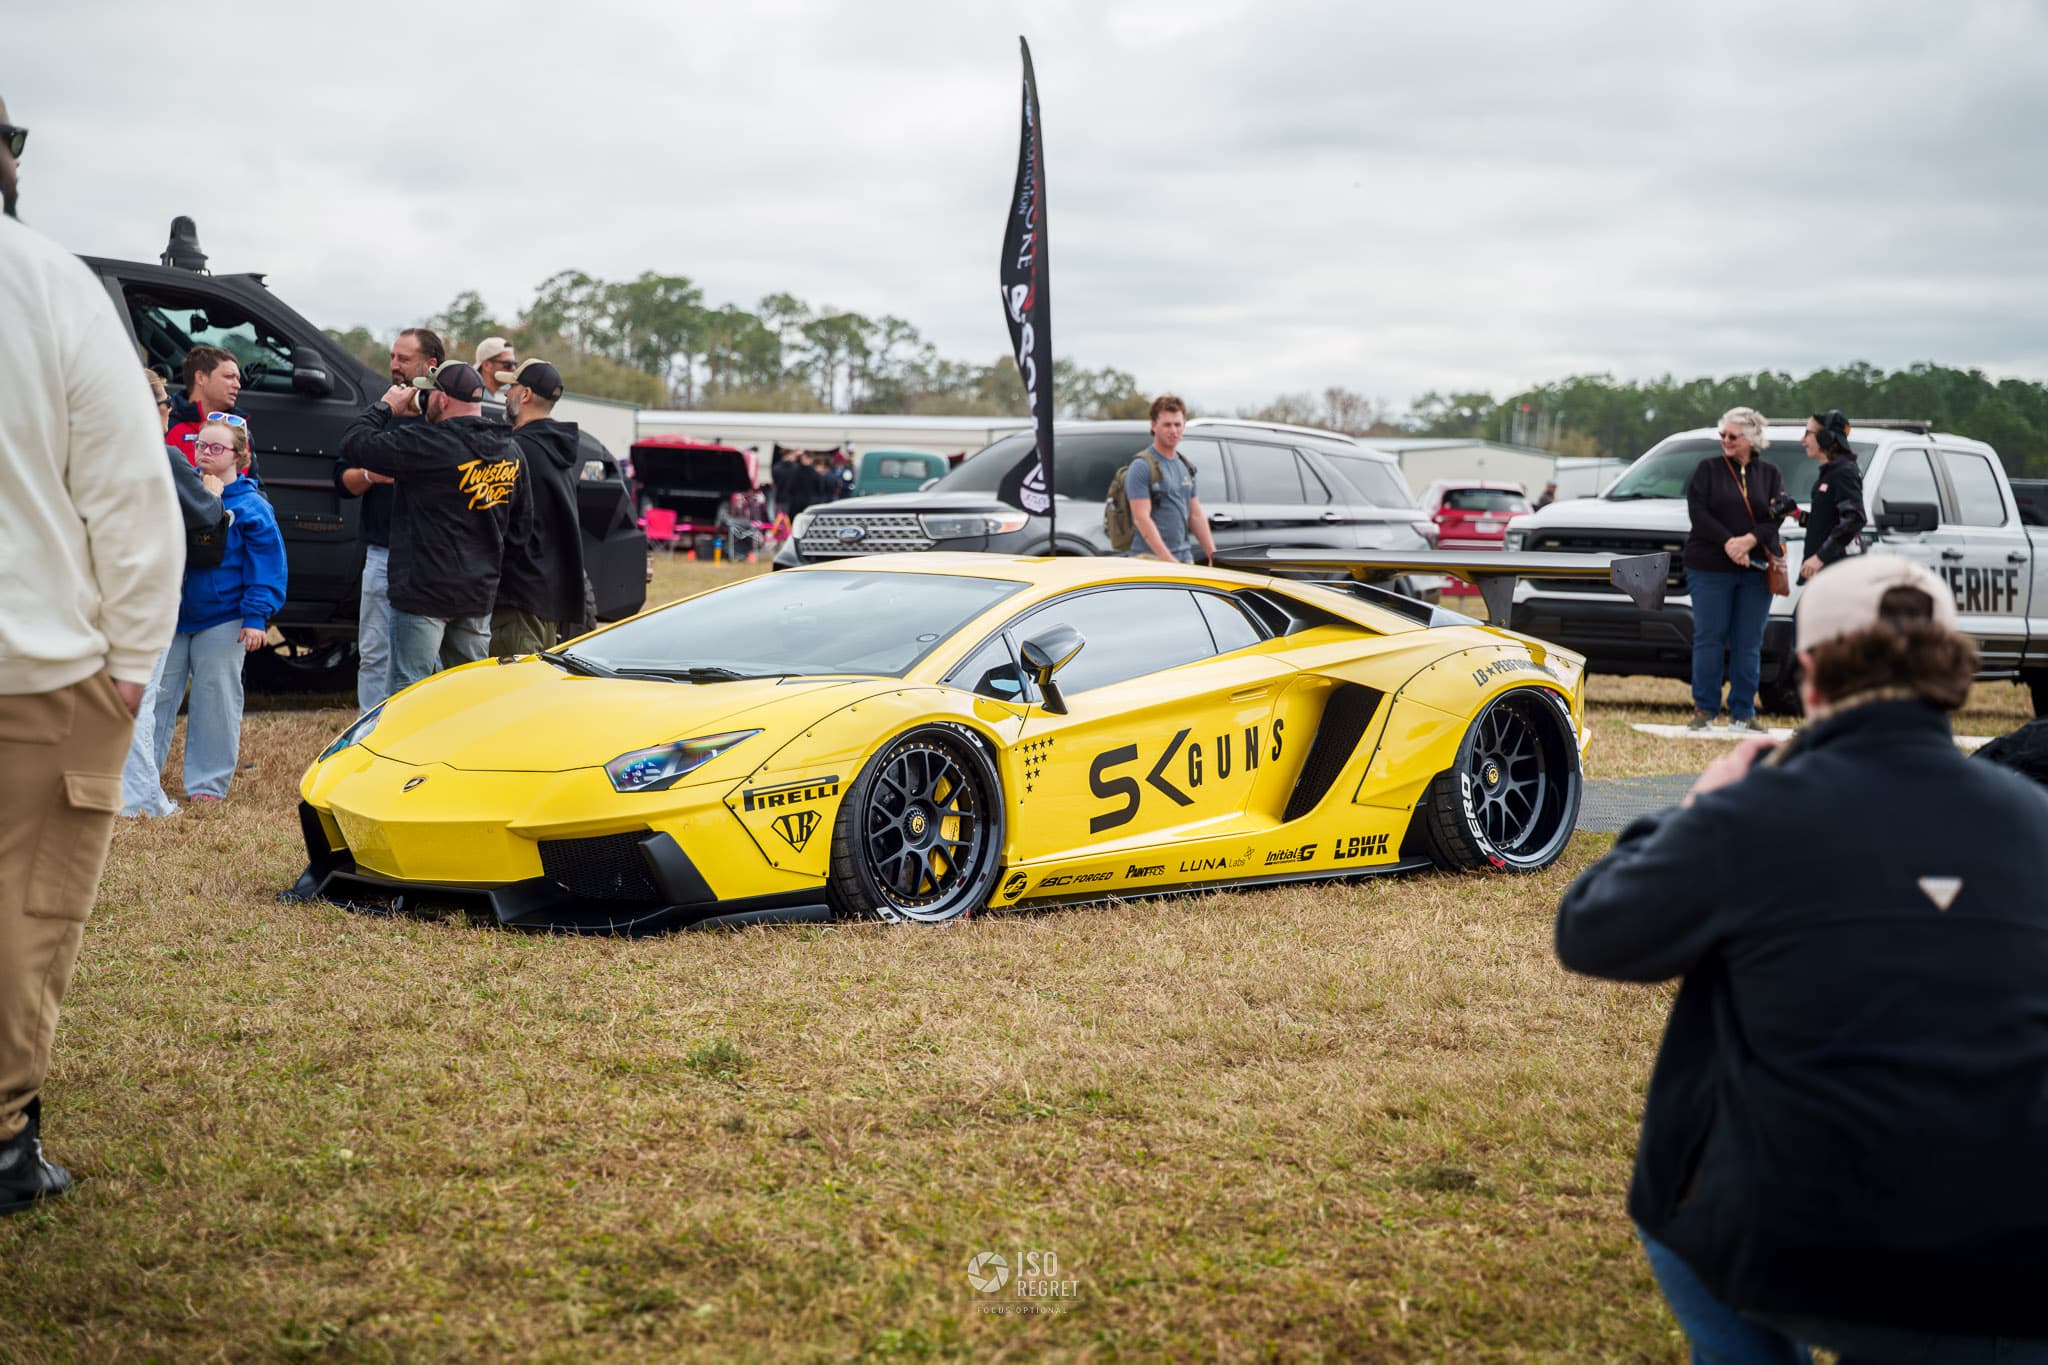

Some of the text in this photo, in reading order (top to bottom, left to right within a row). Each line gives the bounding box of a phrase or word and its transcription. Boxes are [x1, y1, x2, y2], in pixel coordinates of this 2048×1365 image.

[457, 458, 520, 491] Twisted
[464, 482, 514, 510] Pro
[1930, 566, 2019, 612] ERIFF
[1472, 667, 1489, 687] LB
[1188, 718, 1285, 788] GUNS
[742, 774, 840, 812] PIRELLI
[1461, 772, 1494, 856] ZERO
[1266, 848, 1298, 862] Initial
[1334, 833, 1390, 861] LBWK
[1073, 871, 1114, 884] FORGED
[1179, 857, 1227, 873] LUNA
